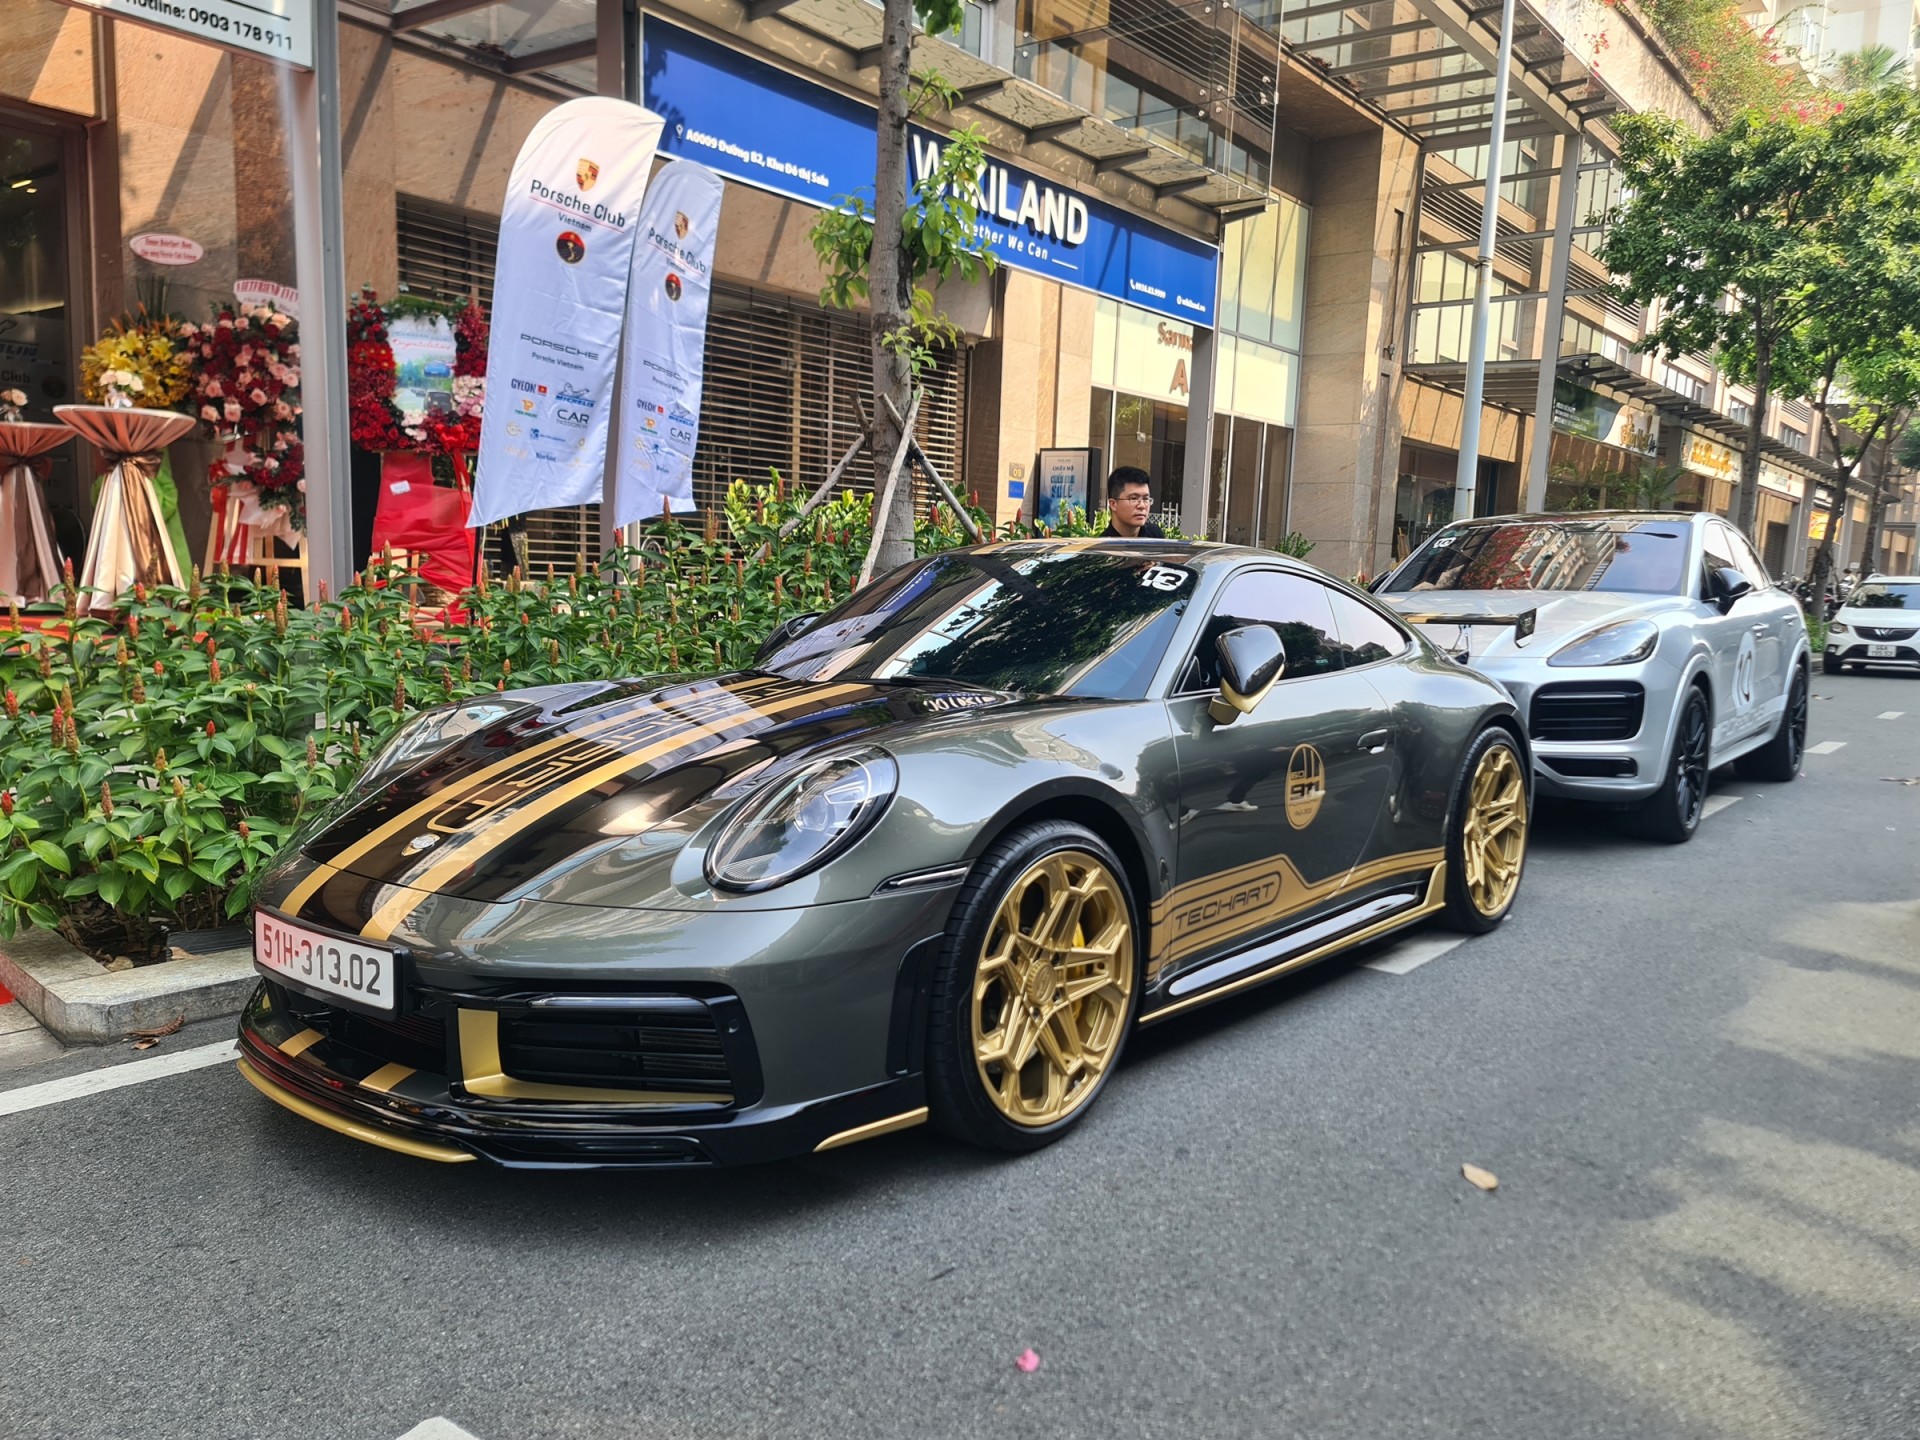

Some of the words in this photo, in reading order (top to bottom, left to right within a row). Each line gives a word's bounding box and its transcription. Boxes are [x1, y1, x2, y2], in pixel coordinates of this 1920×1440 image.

[189, 8, 229, 31] 0903
[233, 21, 262, 41] 178
[265, 30, 292, 50] 911
[686, 129, 718, 149] A0009
[767, 156, 784, 172] Khu
[811, 171, 829, 187] Sala
[530, 179, 591, 214] Porsche
[594, 204, 626, 228] Club
[558, 212, 592, 233] Vietnam
[1008, 234, 1024, 252] We
[1028, 243, 1048, 260] Can
[685, 251, 707, 274] Club
[520, 333, 599, 361] PORSCHE
[532, 351, 556, 365] Porsche
[556, 358, 584, 371] Vietnam
[511, 378, 536, 394] GYEON
[557, 409, 590, 425] CAR
[670, 427, 692, 442] CAR
[1141, 567, 1189, 591] 13
[1736, 650, 1752, 706] 10
[1291, 781, 1320, 799] 911
[1175, 880, 1275, 931] TECHART
[263, 923, 381, 996] 51H-313.02
